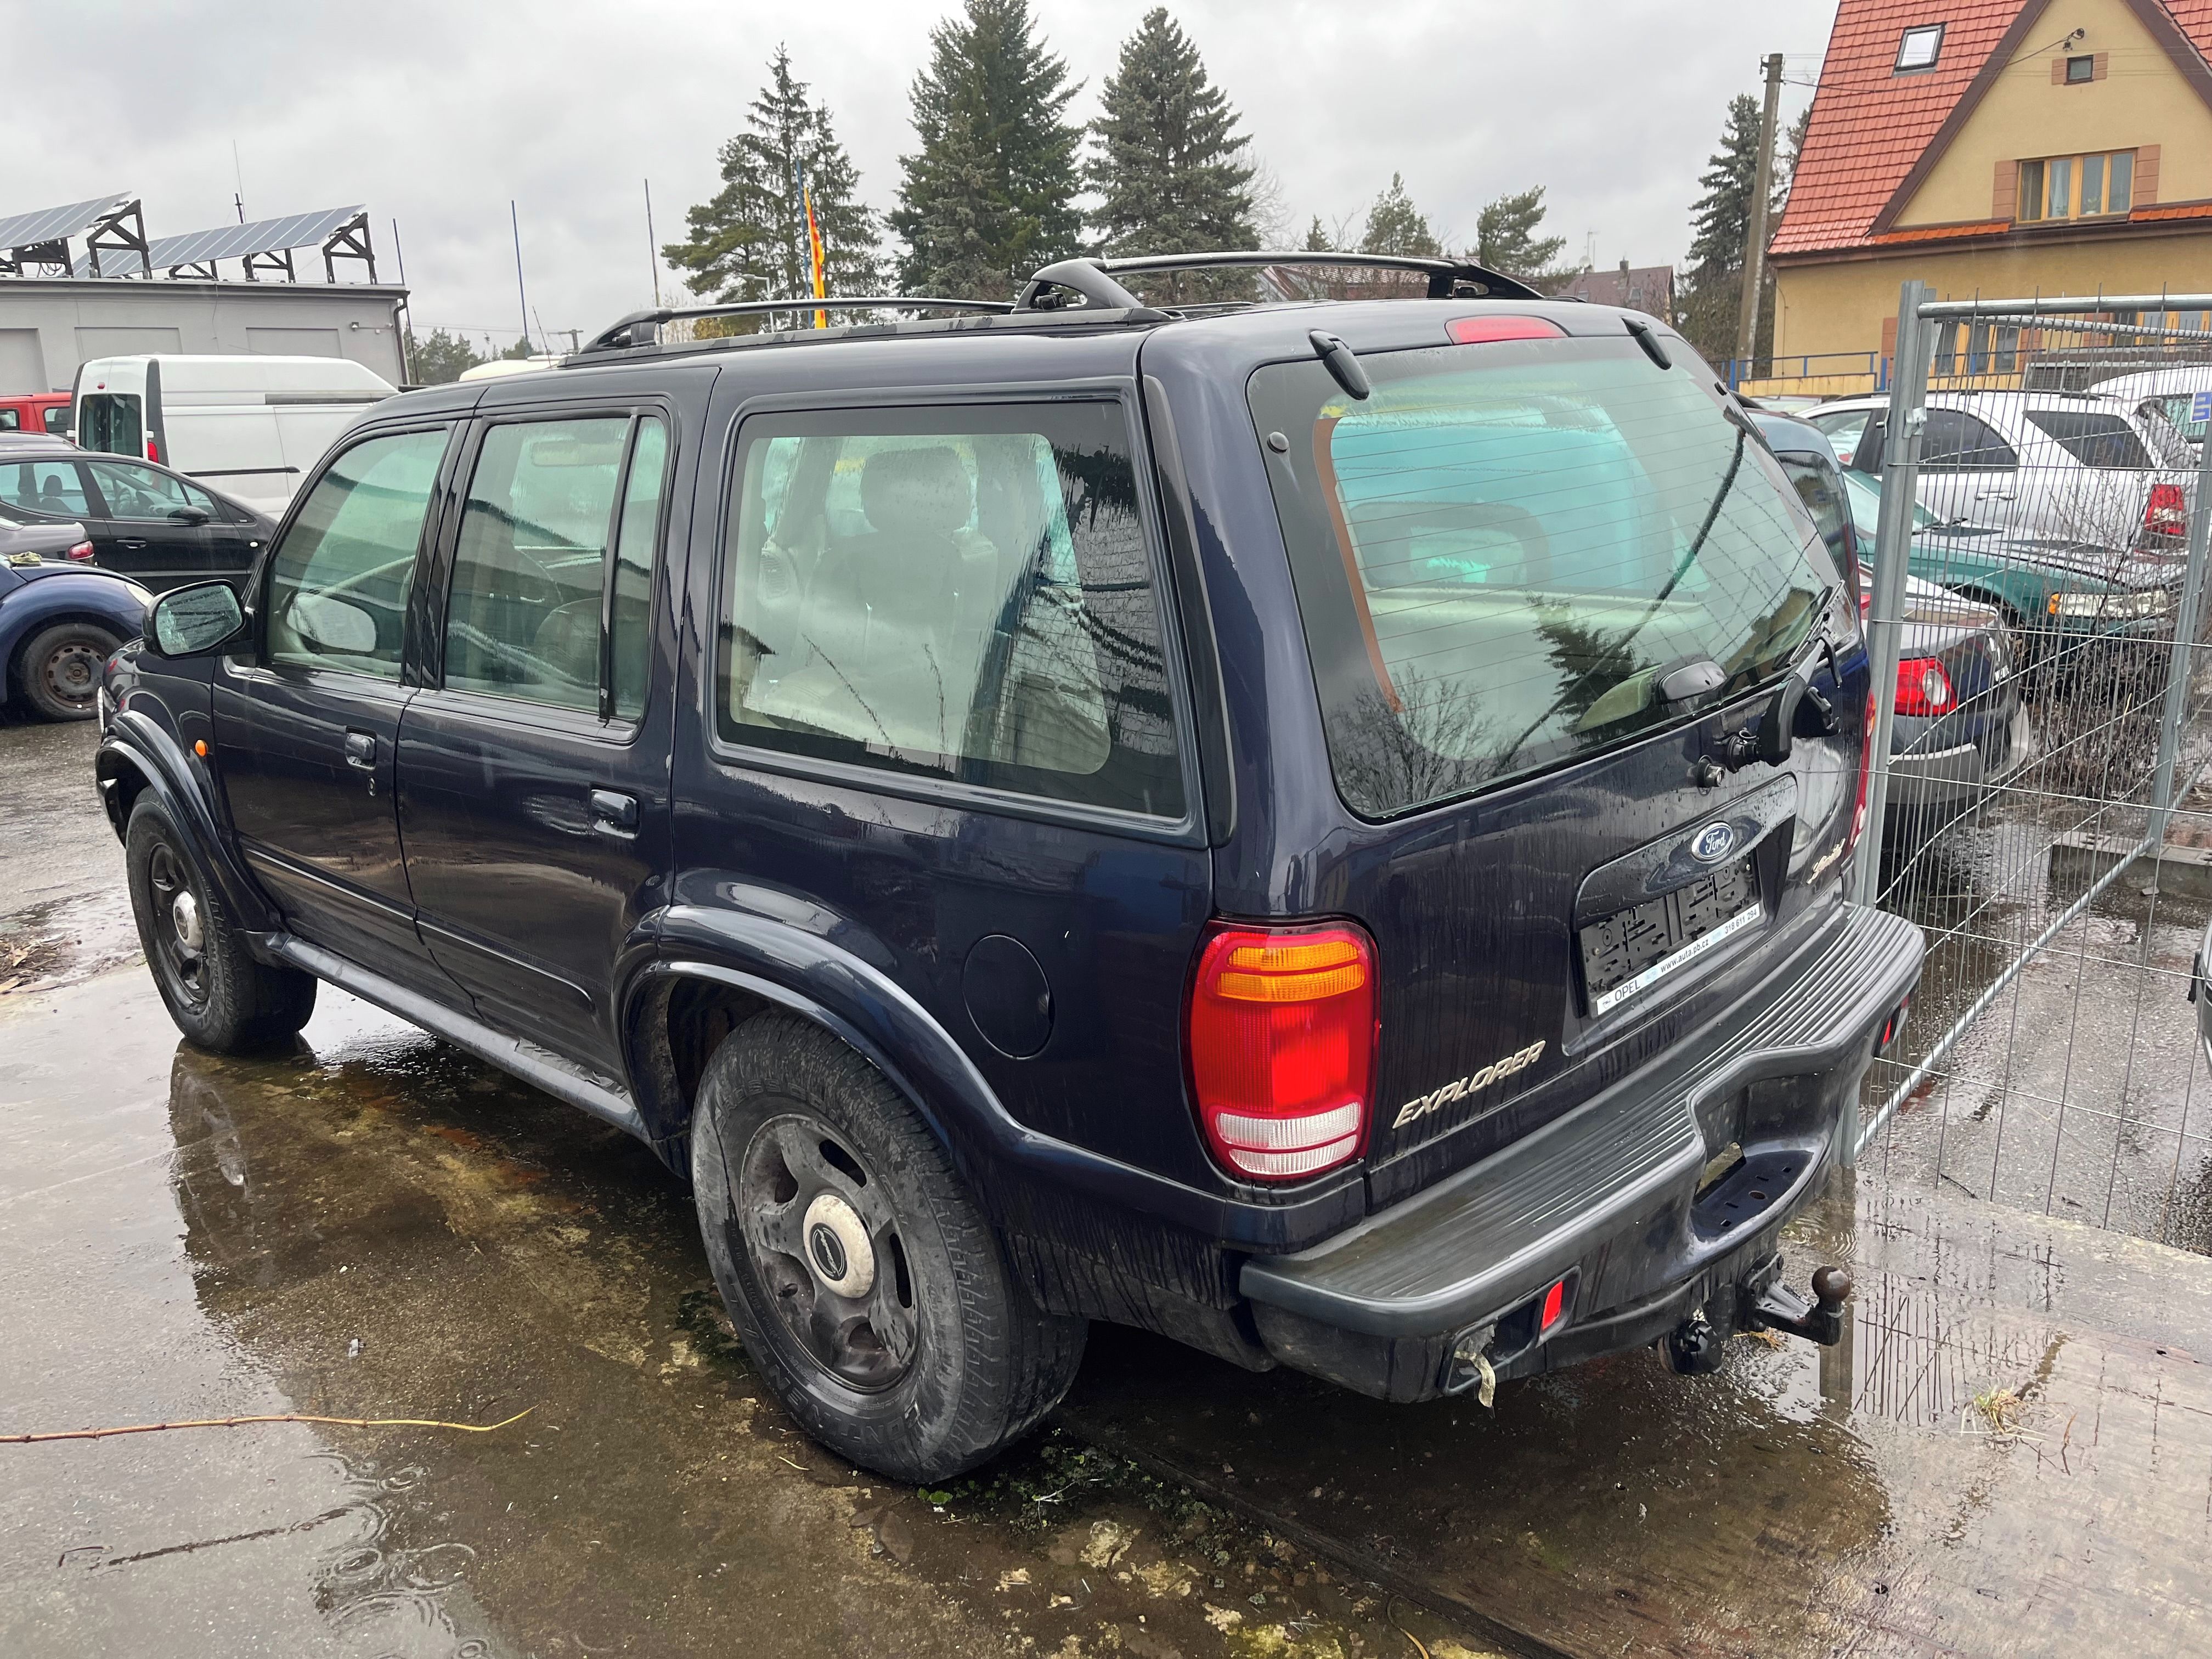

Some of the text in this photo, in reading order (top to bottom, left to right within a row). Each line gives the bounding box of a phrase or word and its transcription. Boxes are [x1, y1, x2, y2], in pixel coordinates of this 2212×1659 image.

[1706, 830, 1726, 854] Ford
[1615, 979, 1641, 1002] OPEL
[1660, 939, 1709, 973] www.auta.pb.cz
[1725, 922, 1735, 934] 318
[1736, 917, 1745, 927] 611
[1747, 908, 1757, 921] 294
[1392, 1040, 1546, 1129] EXPLORER
